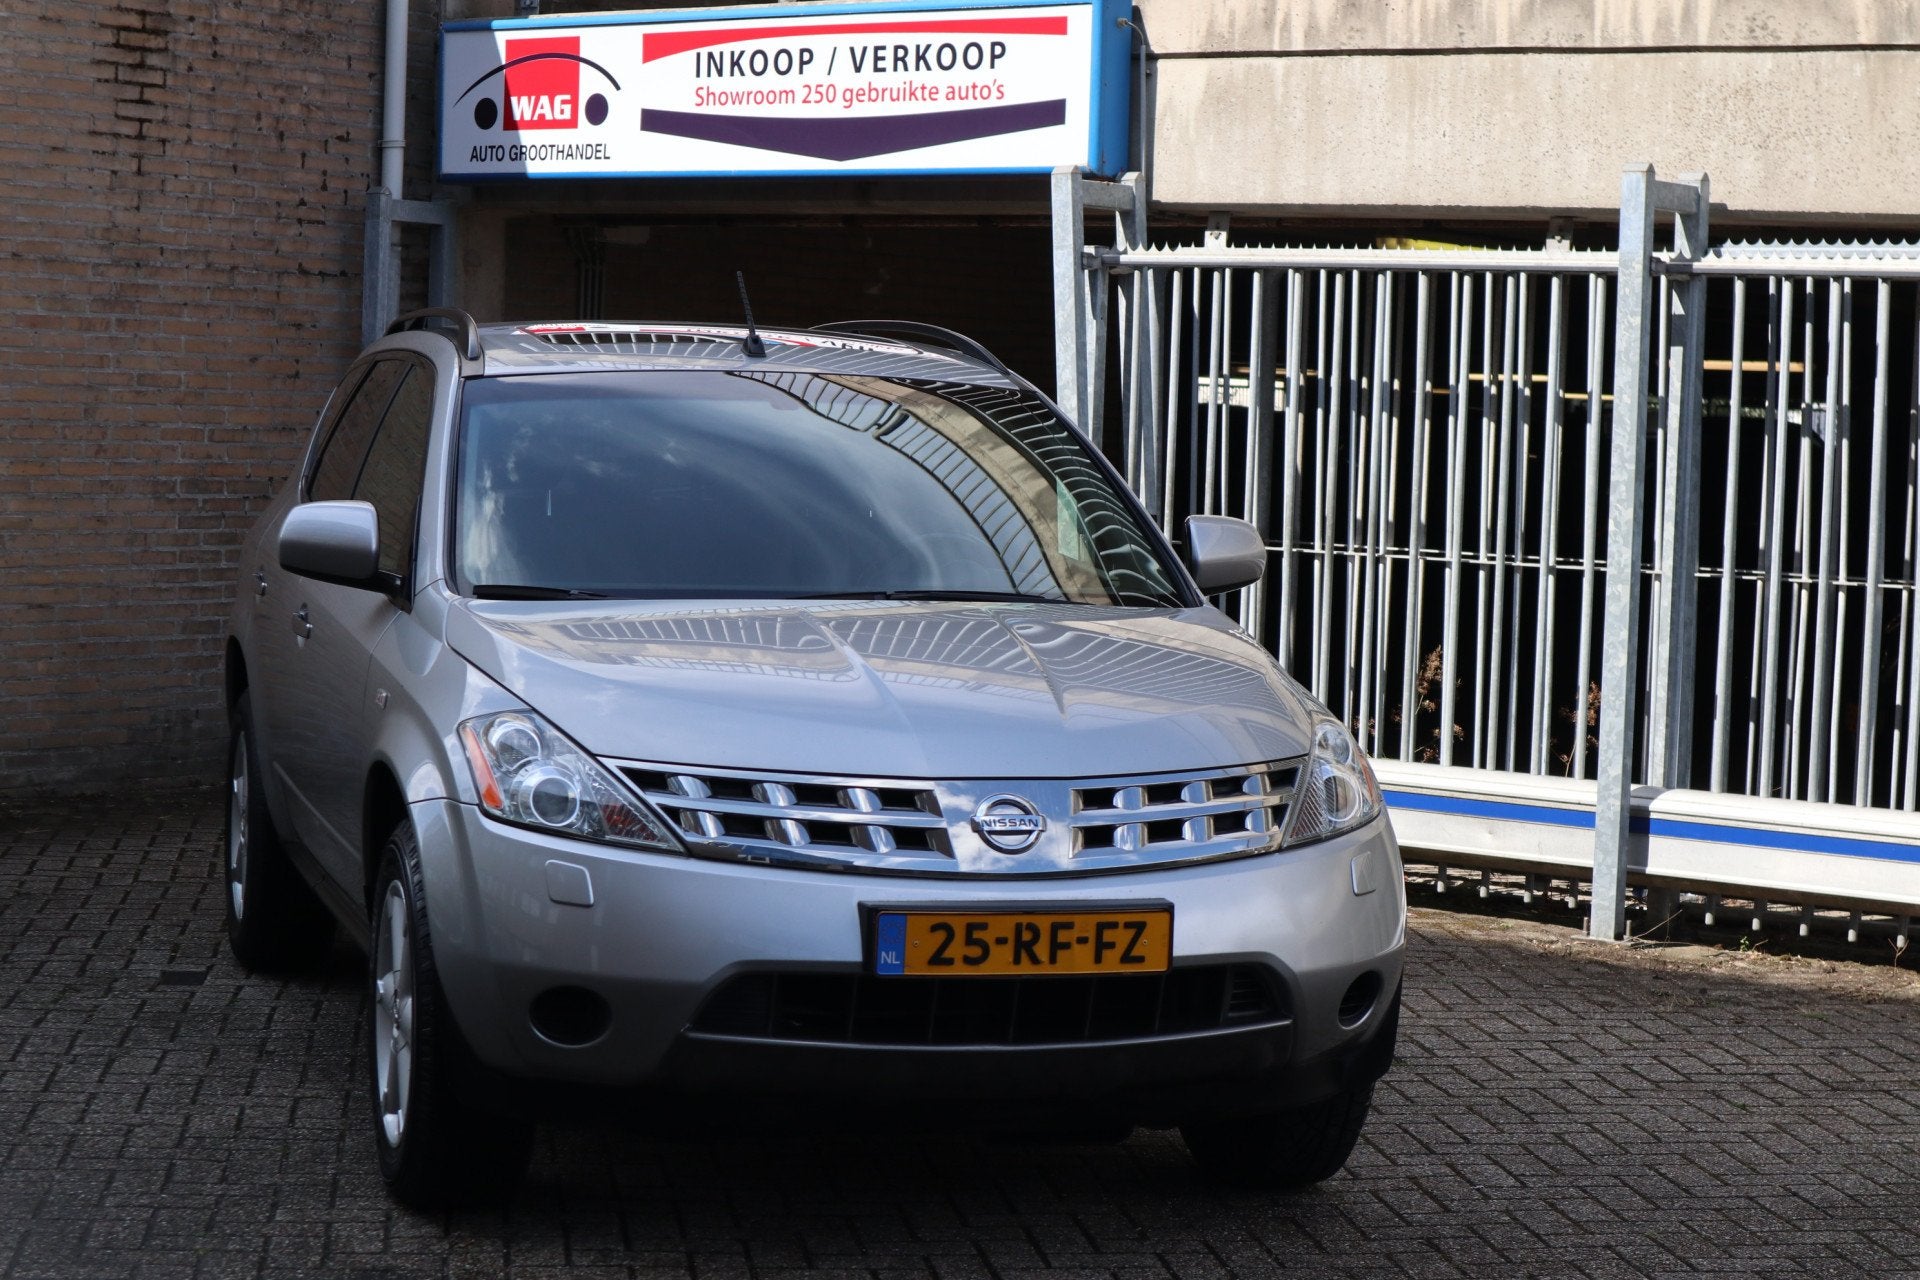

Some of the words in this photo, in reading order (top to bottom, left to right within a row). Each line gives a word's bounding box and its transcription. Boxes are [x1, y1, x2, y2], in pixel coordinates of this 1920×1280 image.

[695, 48, 814, 78] INKOOP
[849, 41, 1007, 74] VERKOOP
[694, 85, 796, 107] Showroom
[802, 84, 836, 104] 250
[842, 82, 938, 109] gebruikte
[945, 78, 1005, 101] auto's
[511, 94, 571, 120] WAG
[469, 145, 505, 162] AUTO
[508, 144, 610, 162] GROOTHANDEL
[980, 817, 1039, 828] NISSAN
[927, 921, 1147, 966] 25-RF-FZ
[881, 951, 900, 964] NL
